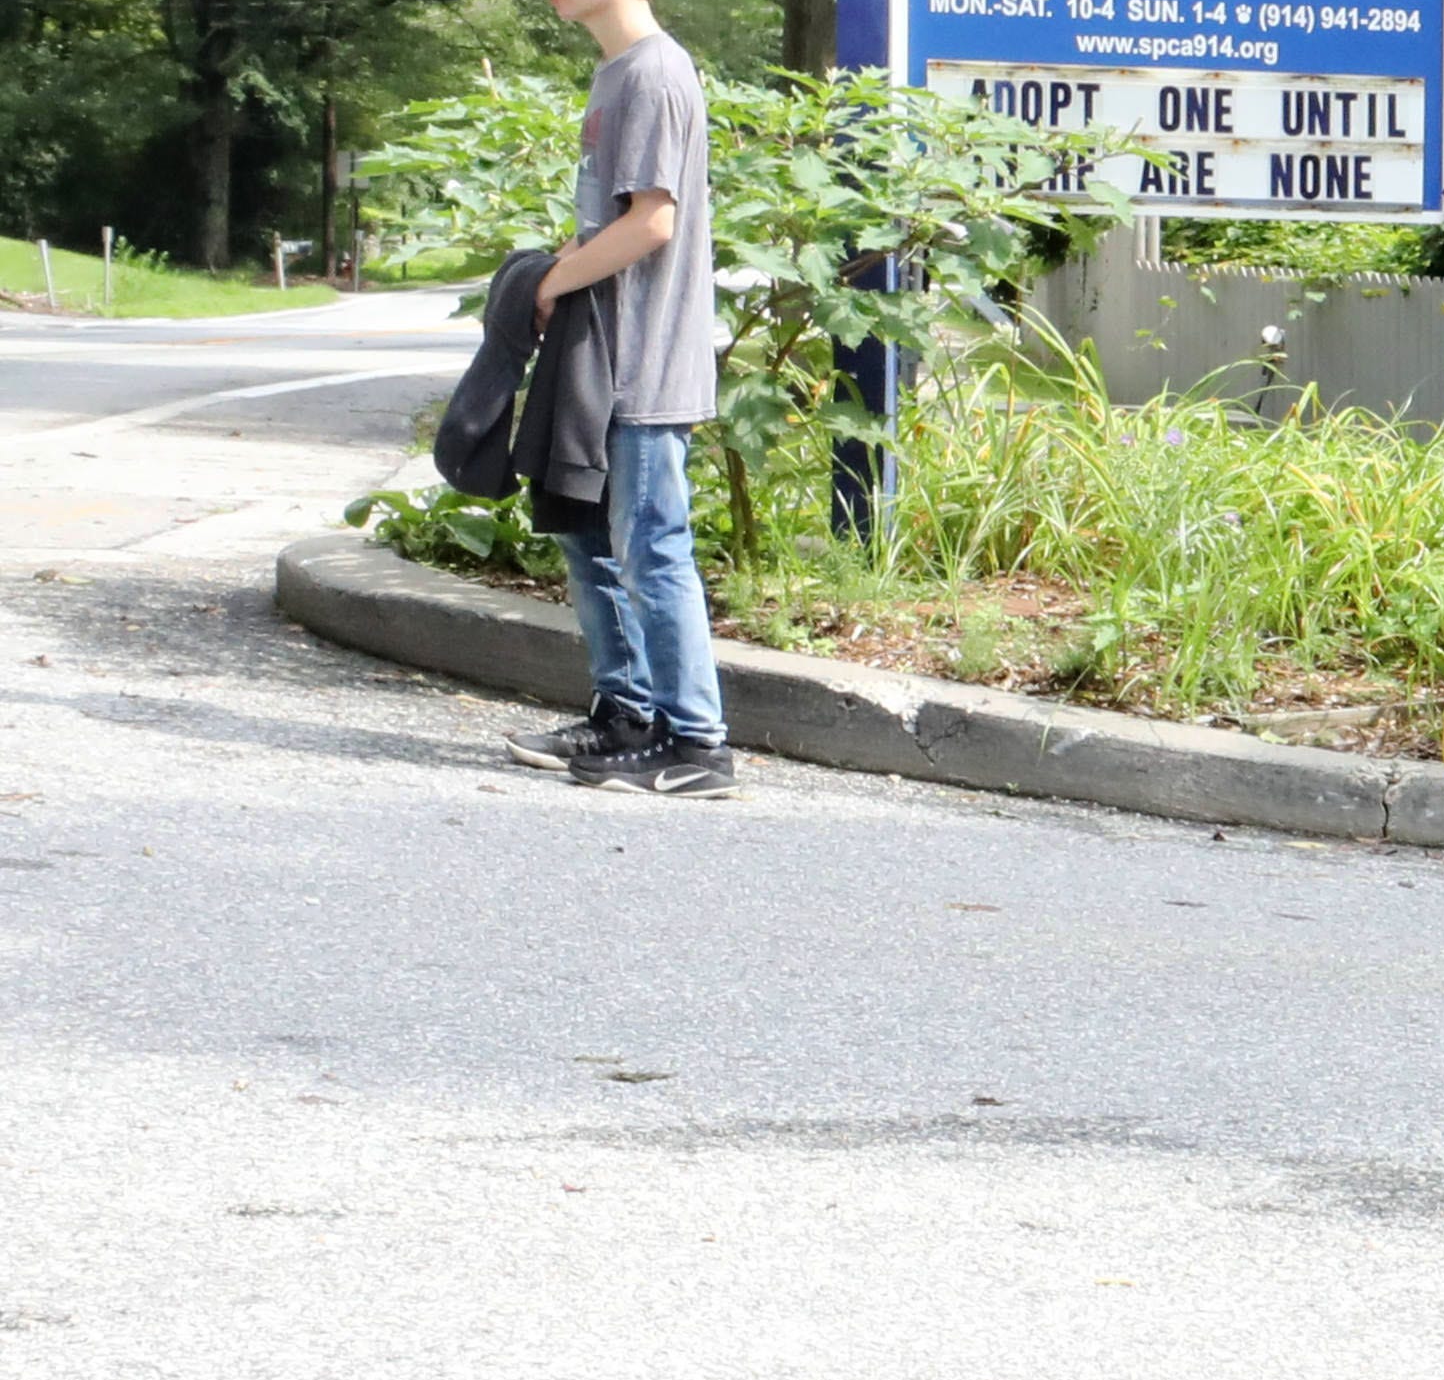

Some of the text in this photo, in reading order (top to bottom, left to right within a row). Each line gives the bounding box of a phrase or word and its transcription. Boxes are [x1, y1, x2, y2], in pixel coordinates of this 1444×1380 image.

[1192, 1, 1227, 24] 1-4
[1259, 4, 1315, 34] (914)
[1321, 7, 1421, 32] 941-2894
[1076, 33, 1278, 65] www.spca914.org
[1159, 85, 1233, 134] ONE
[1282, 90, 1406, 138] UNTIL
[1139, 150, 1215, 196] ARE
[1270, 152, 1372, 200] NONE
